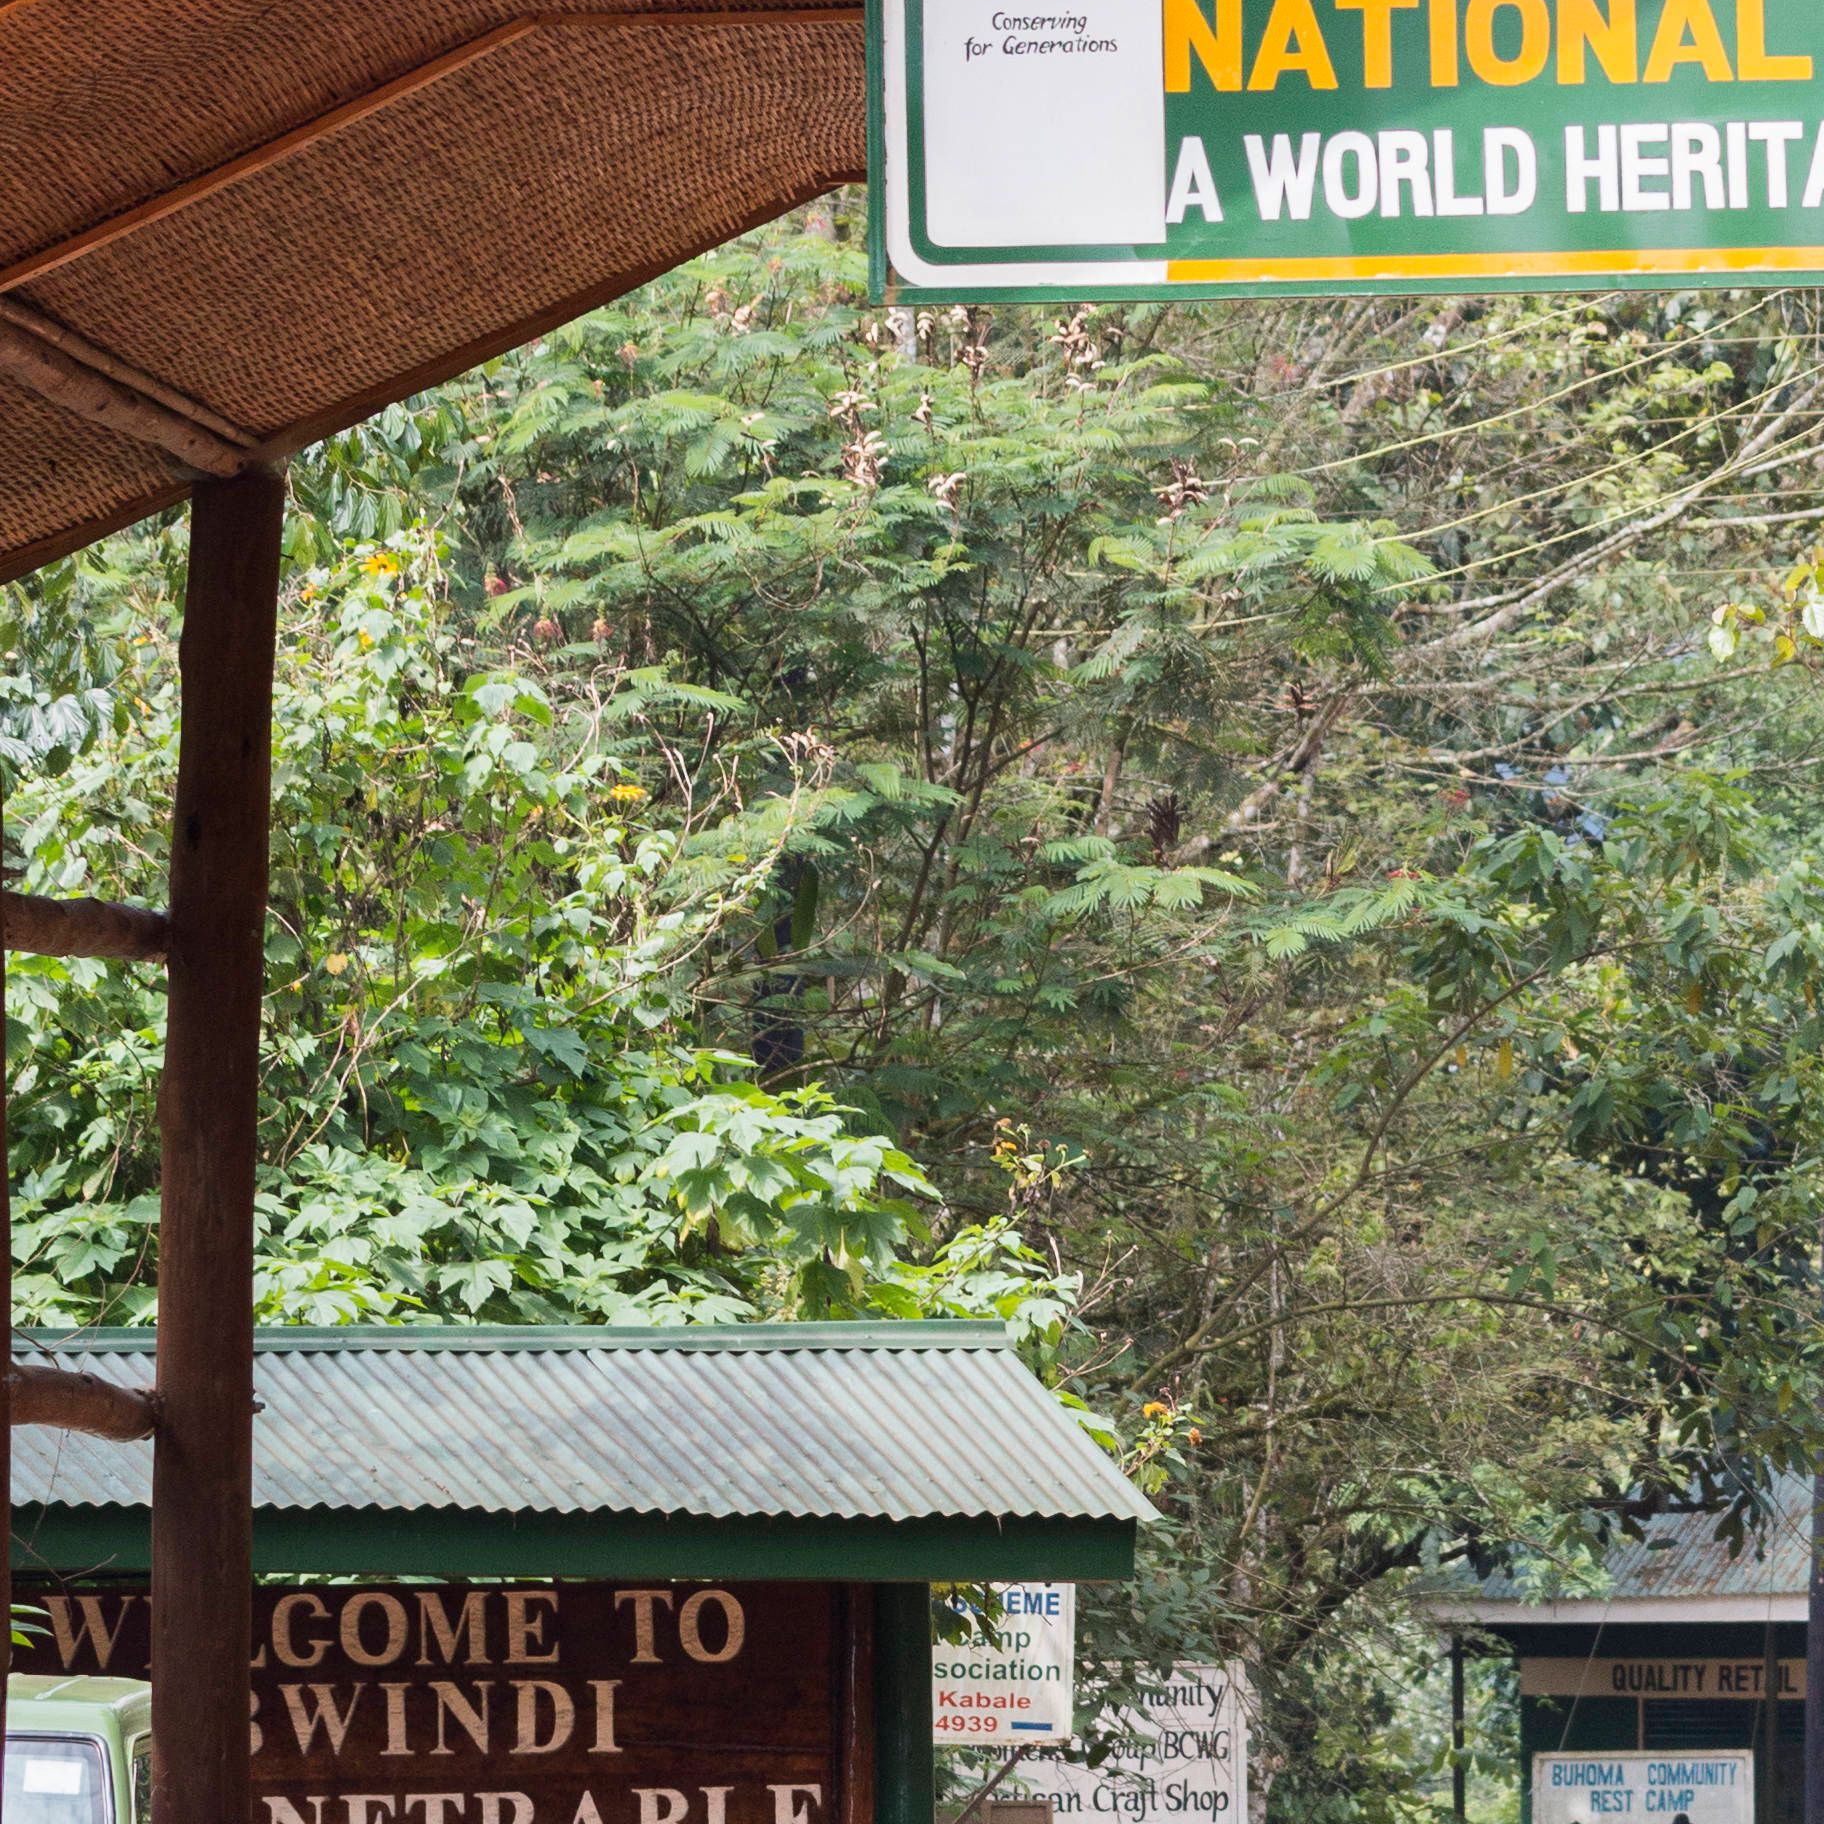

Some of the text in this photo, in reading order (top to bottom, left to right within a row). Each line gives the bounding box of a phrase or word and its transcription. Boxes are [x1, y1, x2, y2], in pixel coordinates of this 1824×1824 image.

[992, 11, 1087, 35] Conserving
[964, 33, 1118, 63] for Generations
[1165, 134, 1224, 224] A
[1243, 124, 1538, 222] WORLD
[614, 1589, 746, 1664] TO
[1613, 1664, 1706, 1692] QUALITY
[1717, 1665, 1797, 1693] RETIL
[939, 1690, 1031, 1709] Kabale
[935, 1715, 998, 1733] 4939
[1551, 1762, 1738, 1786] BUHOMA COMMUNITY
[1093, 1782, 1158, 1823] Craft
[1165, 1779, 1229, 1823] Shop
[1590, 1790, 1695, 1812] REST CAMP
